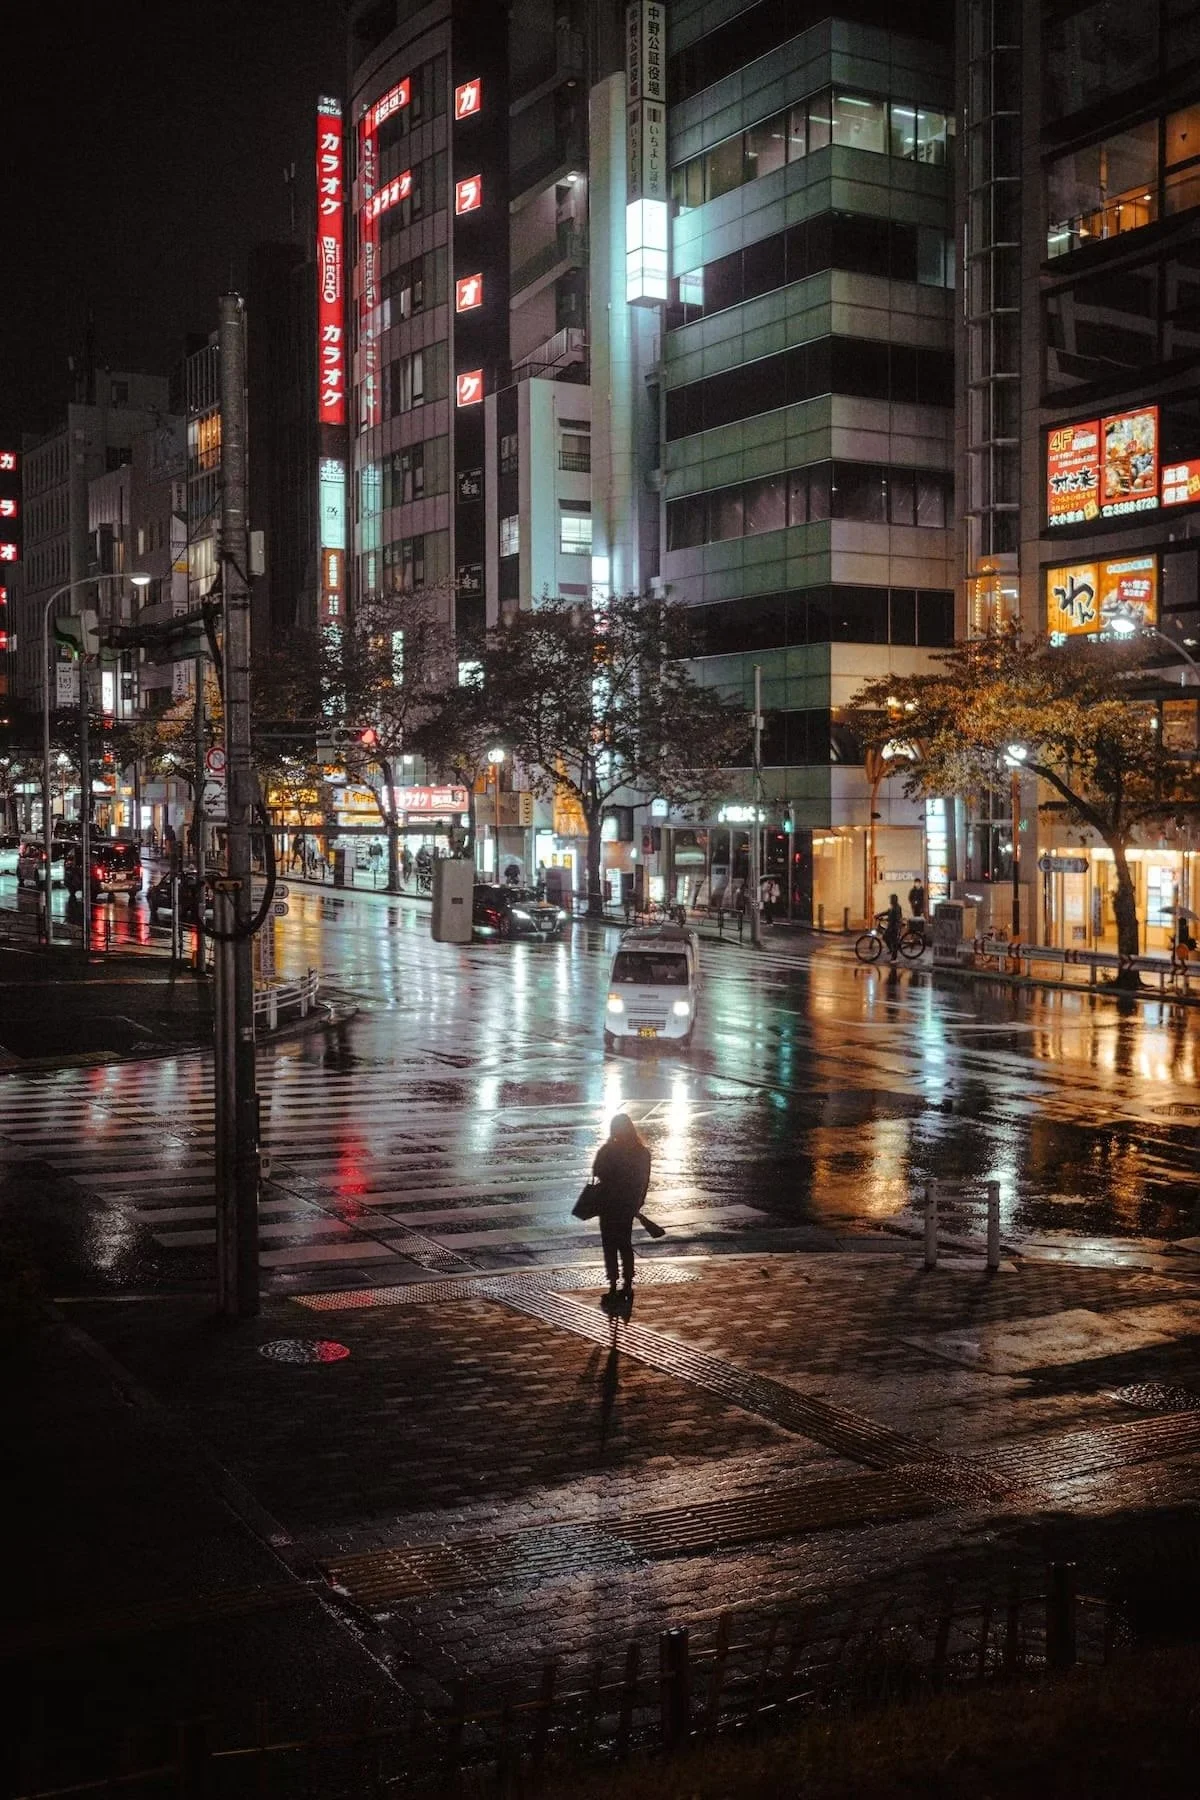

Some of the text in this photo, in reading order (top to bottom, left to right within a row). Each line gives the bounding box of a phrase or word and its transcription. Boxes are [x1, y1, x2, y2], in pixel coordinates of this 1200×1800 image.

[648, 6, 660, 96] 中野公証役場
[321, 133, 341, 215] カラオケ
[323, 236, 336, 303] BIG ECHO
[460, 84, 479, 401] カラオケ
[322, 324, 342, 406] カラオケ
[1050, 429, 1074, 451] 4F
[1050, 631, 1067, 647] 3F
